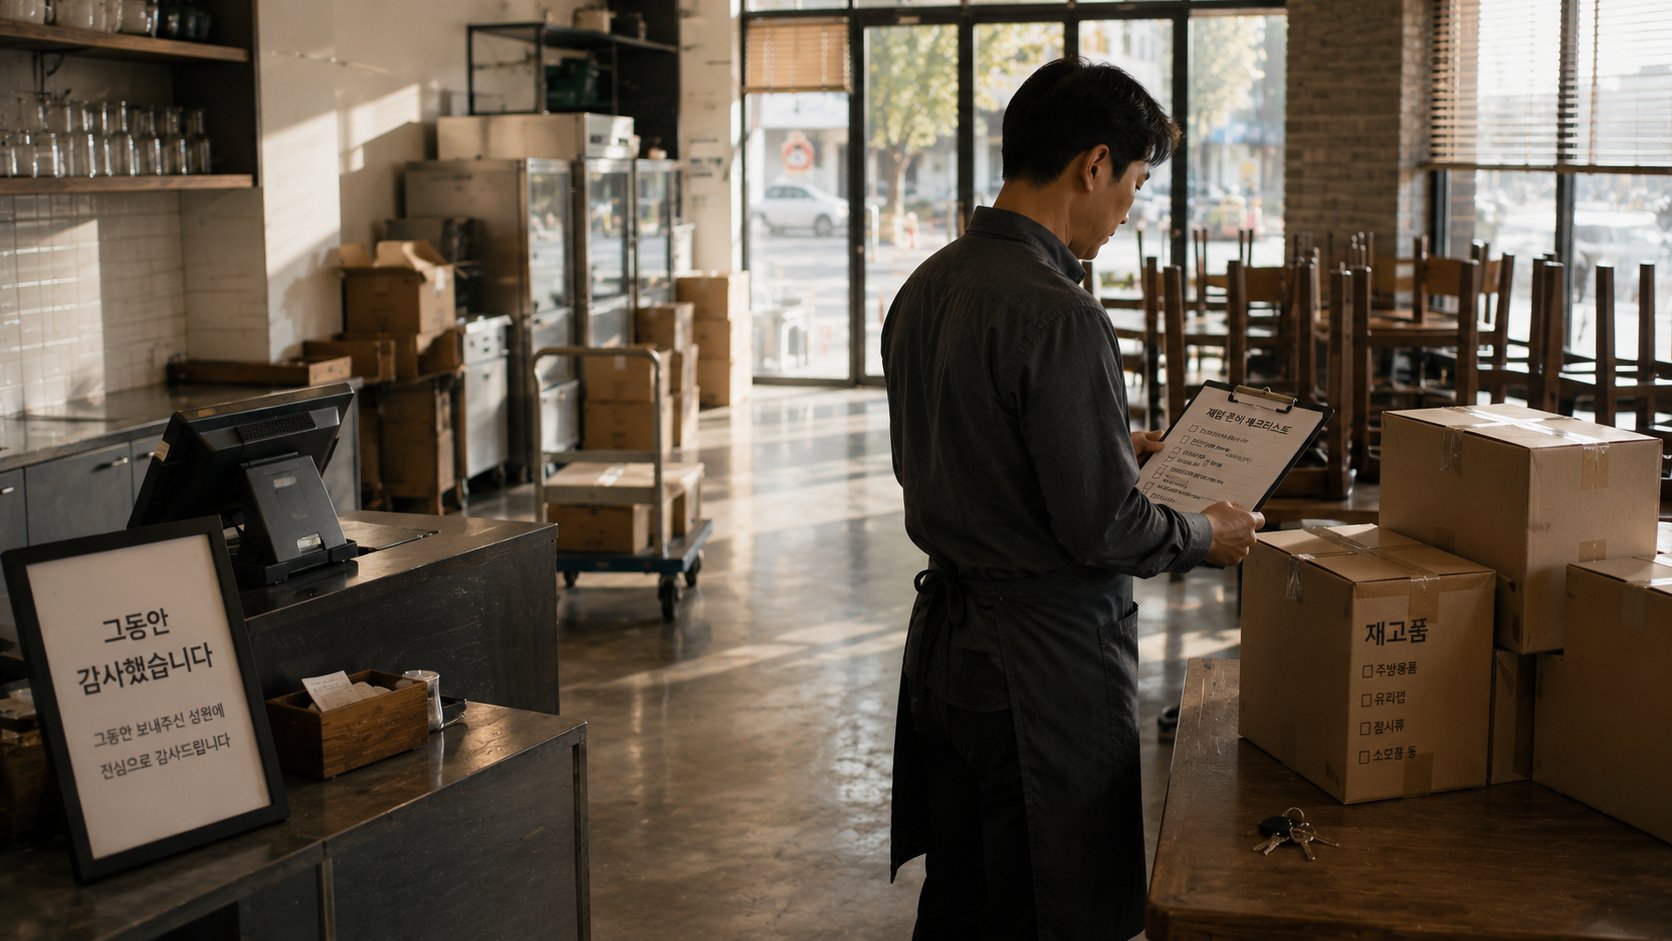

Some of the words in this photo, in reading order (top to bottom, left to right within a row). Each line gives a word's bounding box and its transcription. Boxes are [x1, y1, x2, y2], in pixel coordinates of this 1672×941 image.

[103, 608, 170, 643] 그동안
[1365, 618, 1428, 646] 재고품
[77, 642, 213, 696] 감사했습니다
[1375, 661, 1418, 677] 주방용품
[94, 725, 133, 748] 그동안
[136, 712, 186, 737] 보내주신
[189, 702, 225, 725] 성원에
[100, 753, 152, 780] 진심으로
[155, 732, 231, 766] 감사드립니다
